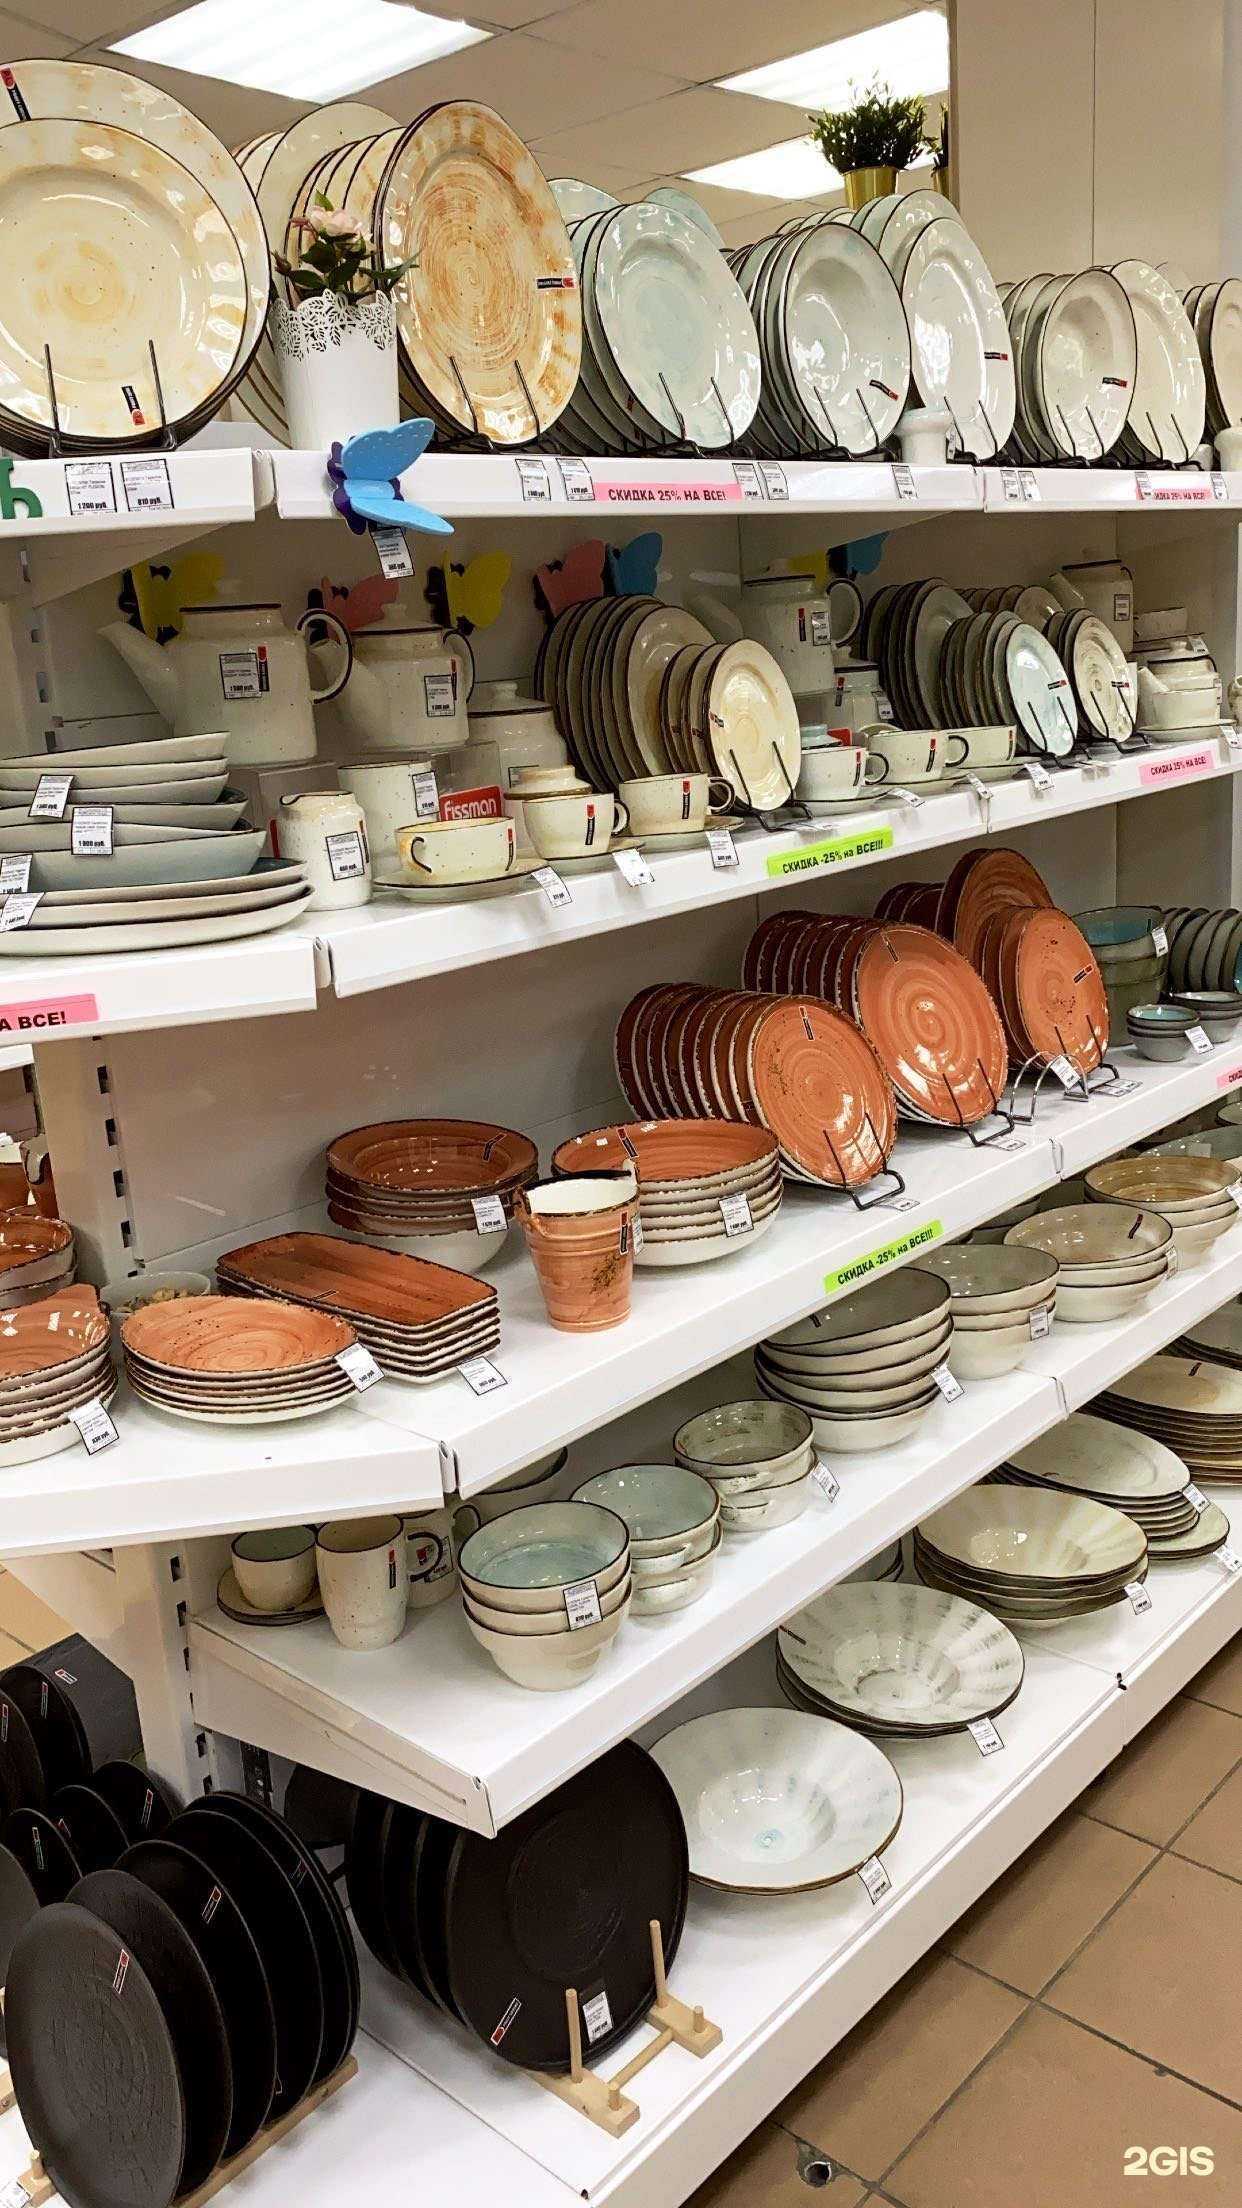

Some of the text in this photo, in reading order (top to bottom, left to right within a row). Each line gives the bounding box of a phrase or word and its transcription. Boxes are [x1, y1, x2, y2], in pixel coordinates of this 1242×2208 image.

[608, 488, 655, 501] СКИДКА
[658, 489, 681, 501] 25%
[684, 489, 700, 501] НА
[1150, 763, 1173, 776] СКИДКА
[782, 839, 884, 874] СКИДКА -25% на ВСЕ!!!
[18, 1011, 67, 1030] ВСЕ!
[837, 1228, 934, 1285] СКИДКА -25% на ВСЕ!!!
